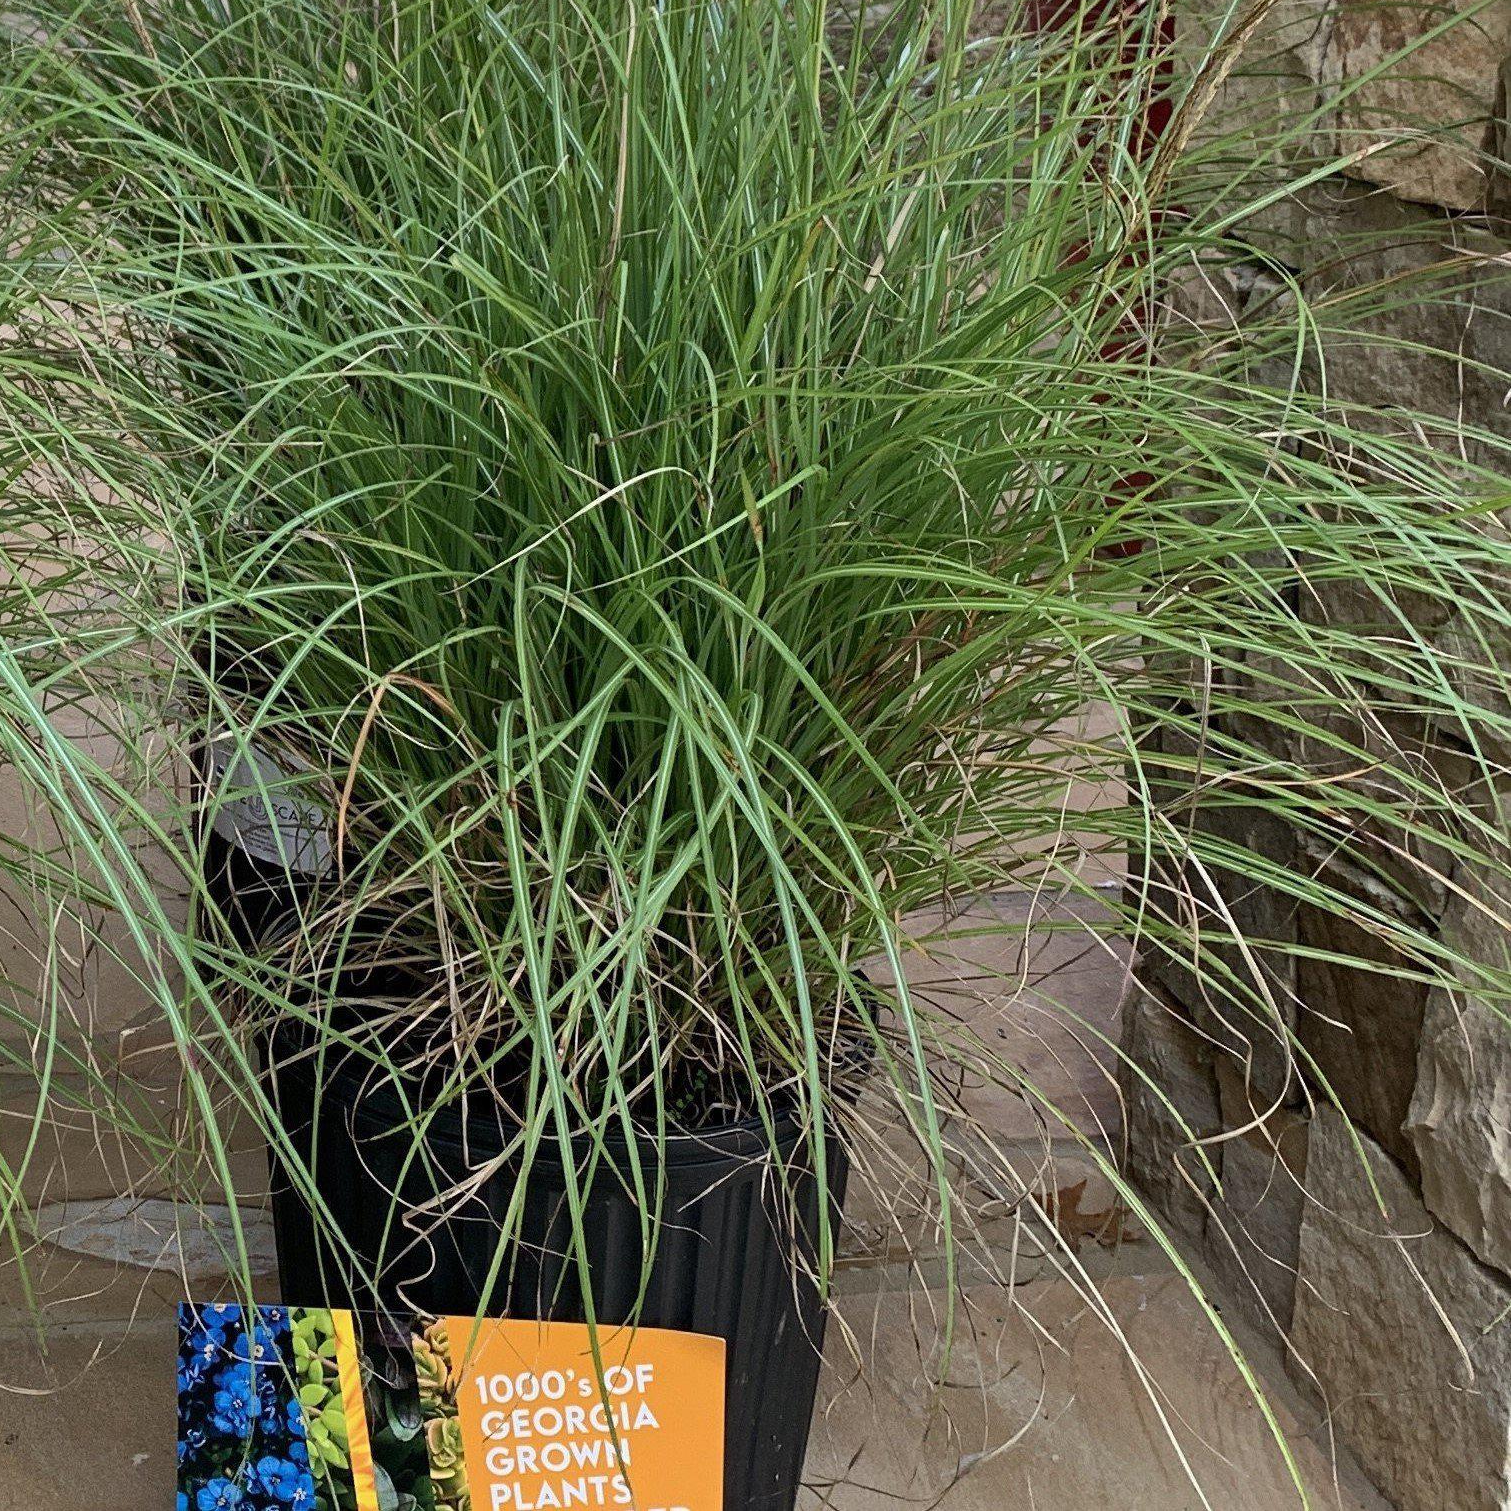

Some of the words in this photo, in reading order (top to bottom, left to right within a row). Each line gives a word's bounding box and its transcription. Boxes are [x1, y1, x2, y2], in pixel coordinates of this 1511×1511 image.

[475, 1369, 592, 1405] 1000's
[603, 1364, 654, 1395] OF
[480, 1400, 660, 1440] GEORGIA
[486, 1438, 631, 1476] GROWN
[490, 1473, 632, 1511] PLANTS
